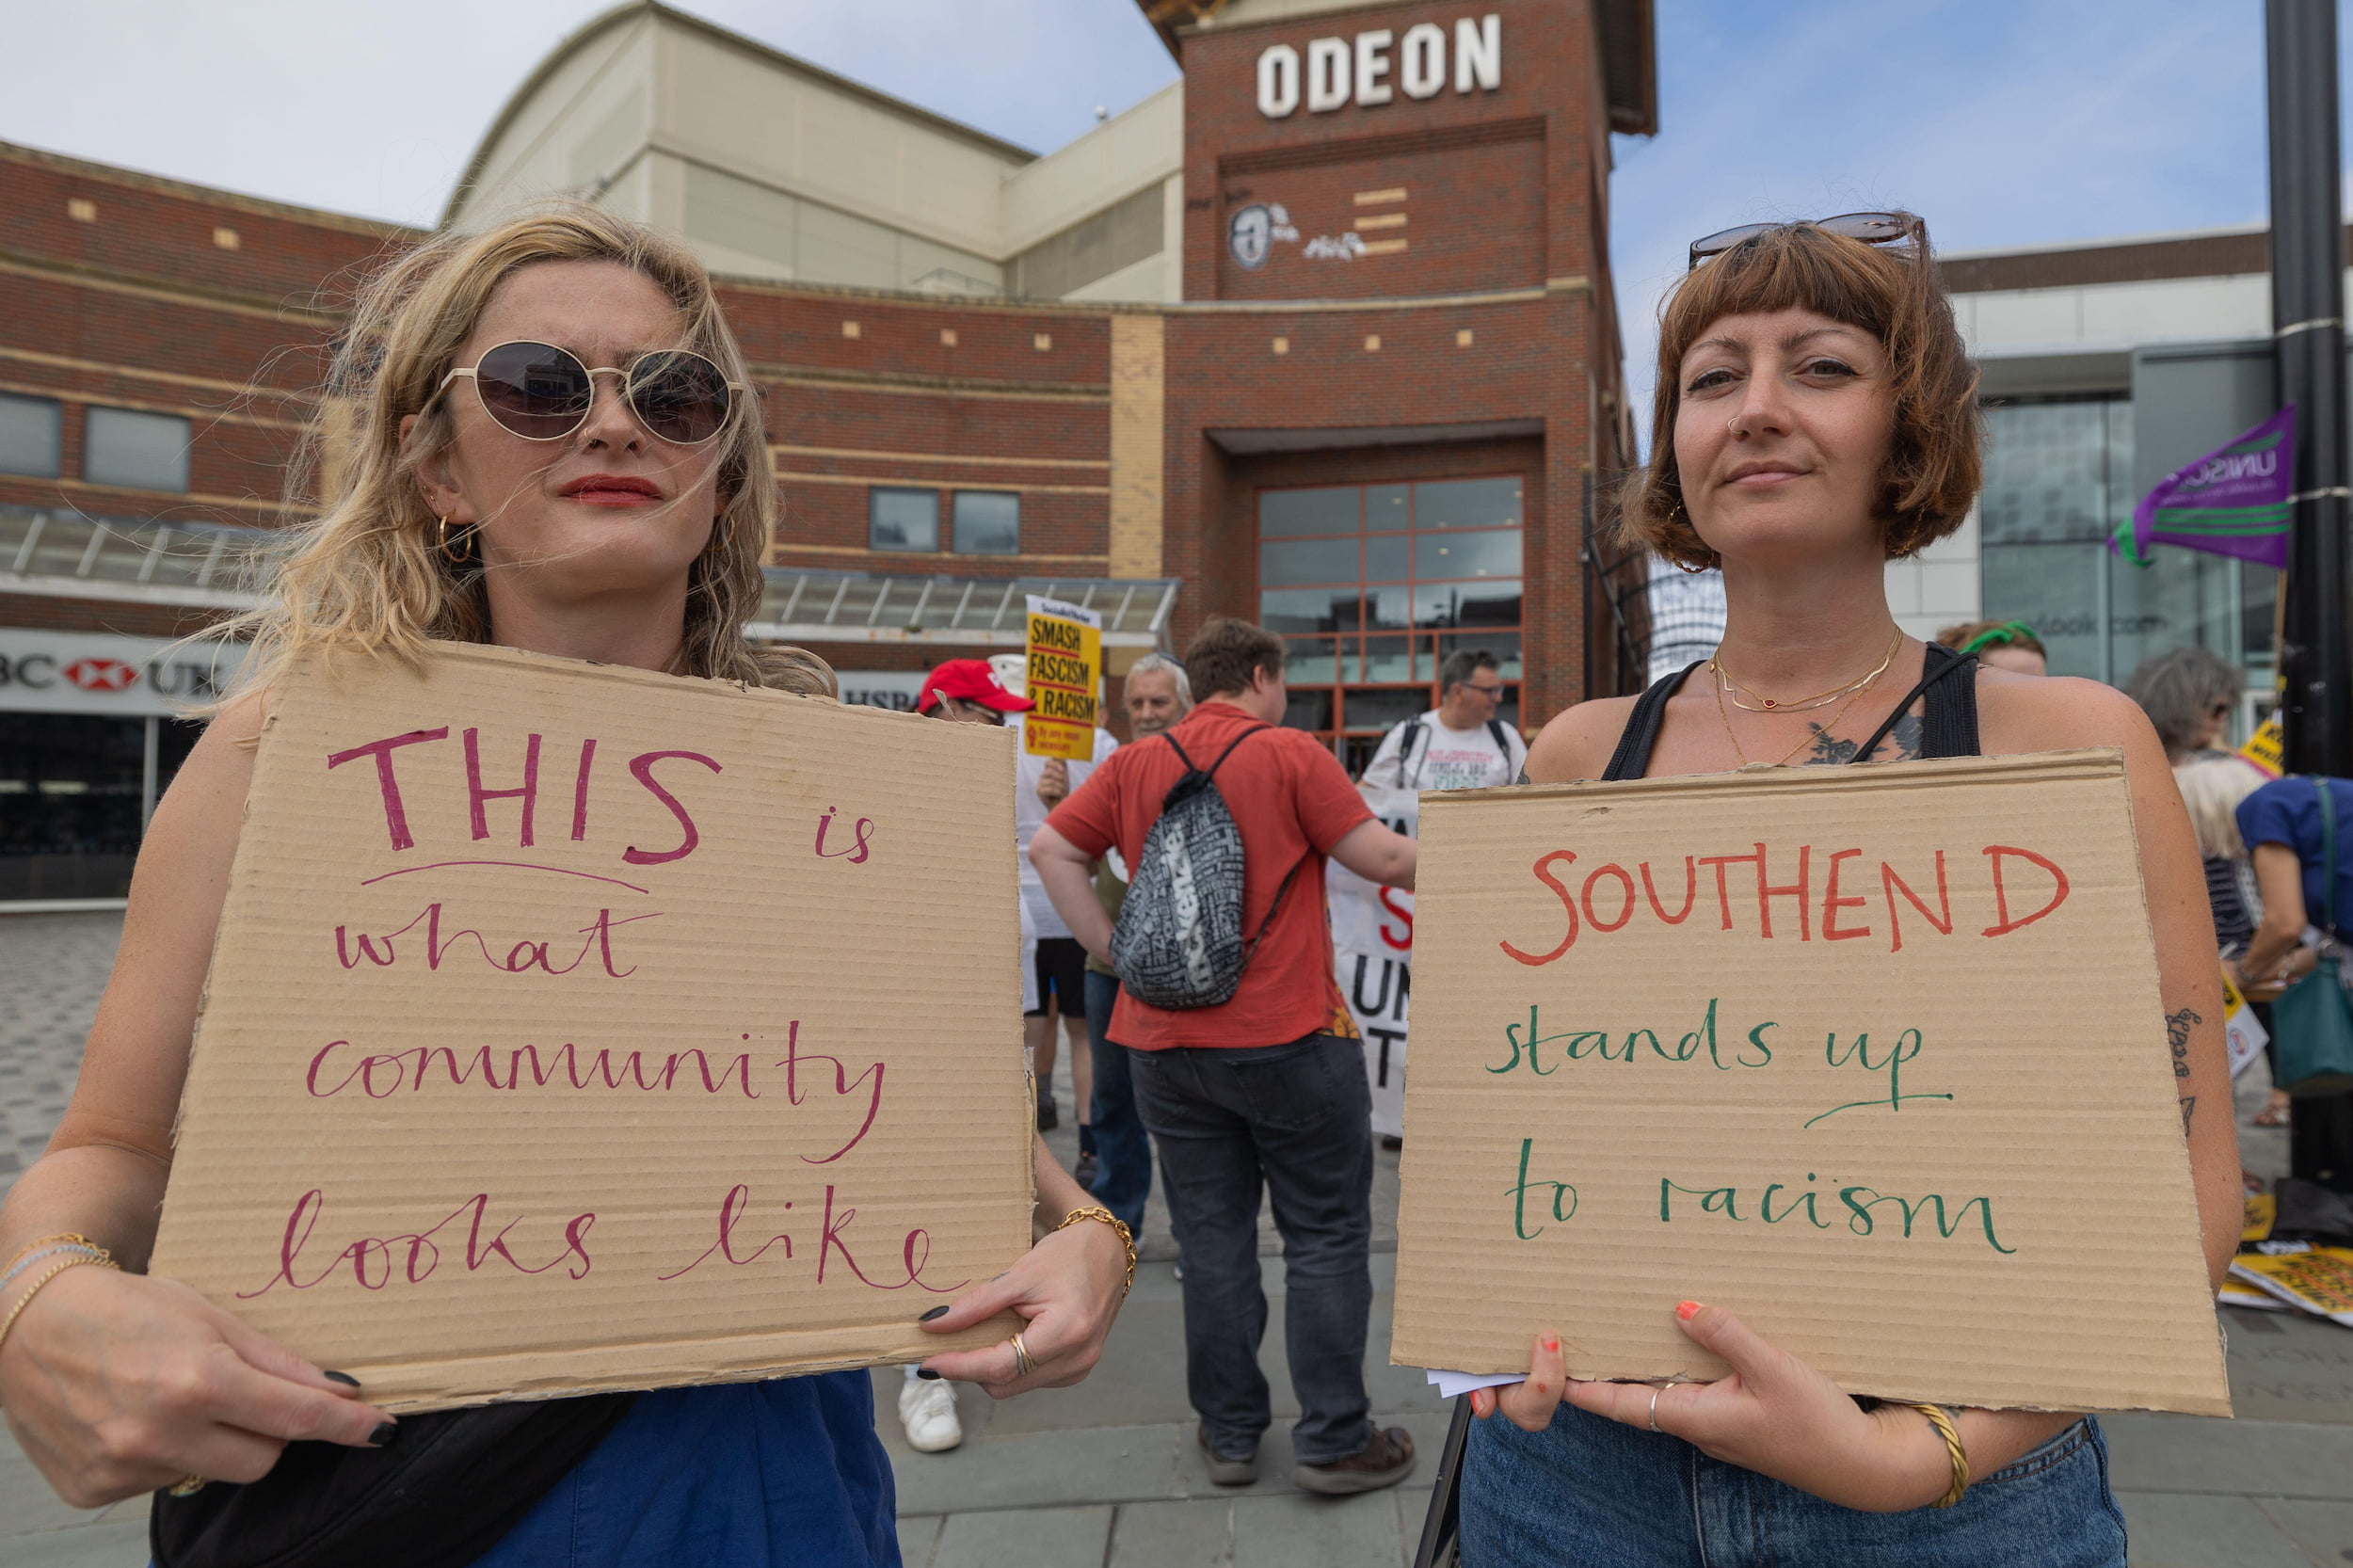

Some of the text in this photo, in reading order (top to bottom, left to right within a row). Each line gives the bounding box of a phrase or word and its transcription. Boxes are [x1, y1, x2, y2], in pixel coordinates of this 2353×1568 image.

[1257, 13, 1501, 120] ODEON
[1030, 653, 1090, 686] FASCISM
[1032, 618, 1081, 651] SMASH
[1044, 690, 1096, 721] RACISM
[328, 726, 875, 865] THIS is
[335, 903, 664, 978] what
[1499, 842, 2070, 967] SOUTHEND
[307, 1019, 885, 1164] community
[1485, 998, 1924, 1112] stands up
[235, 1183, 971, 1299] looks like
[1504, 1138, 2018, 1255] to racism
